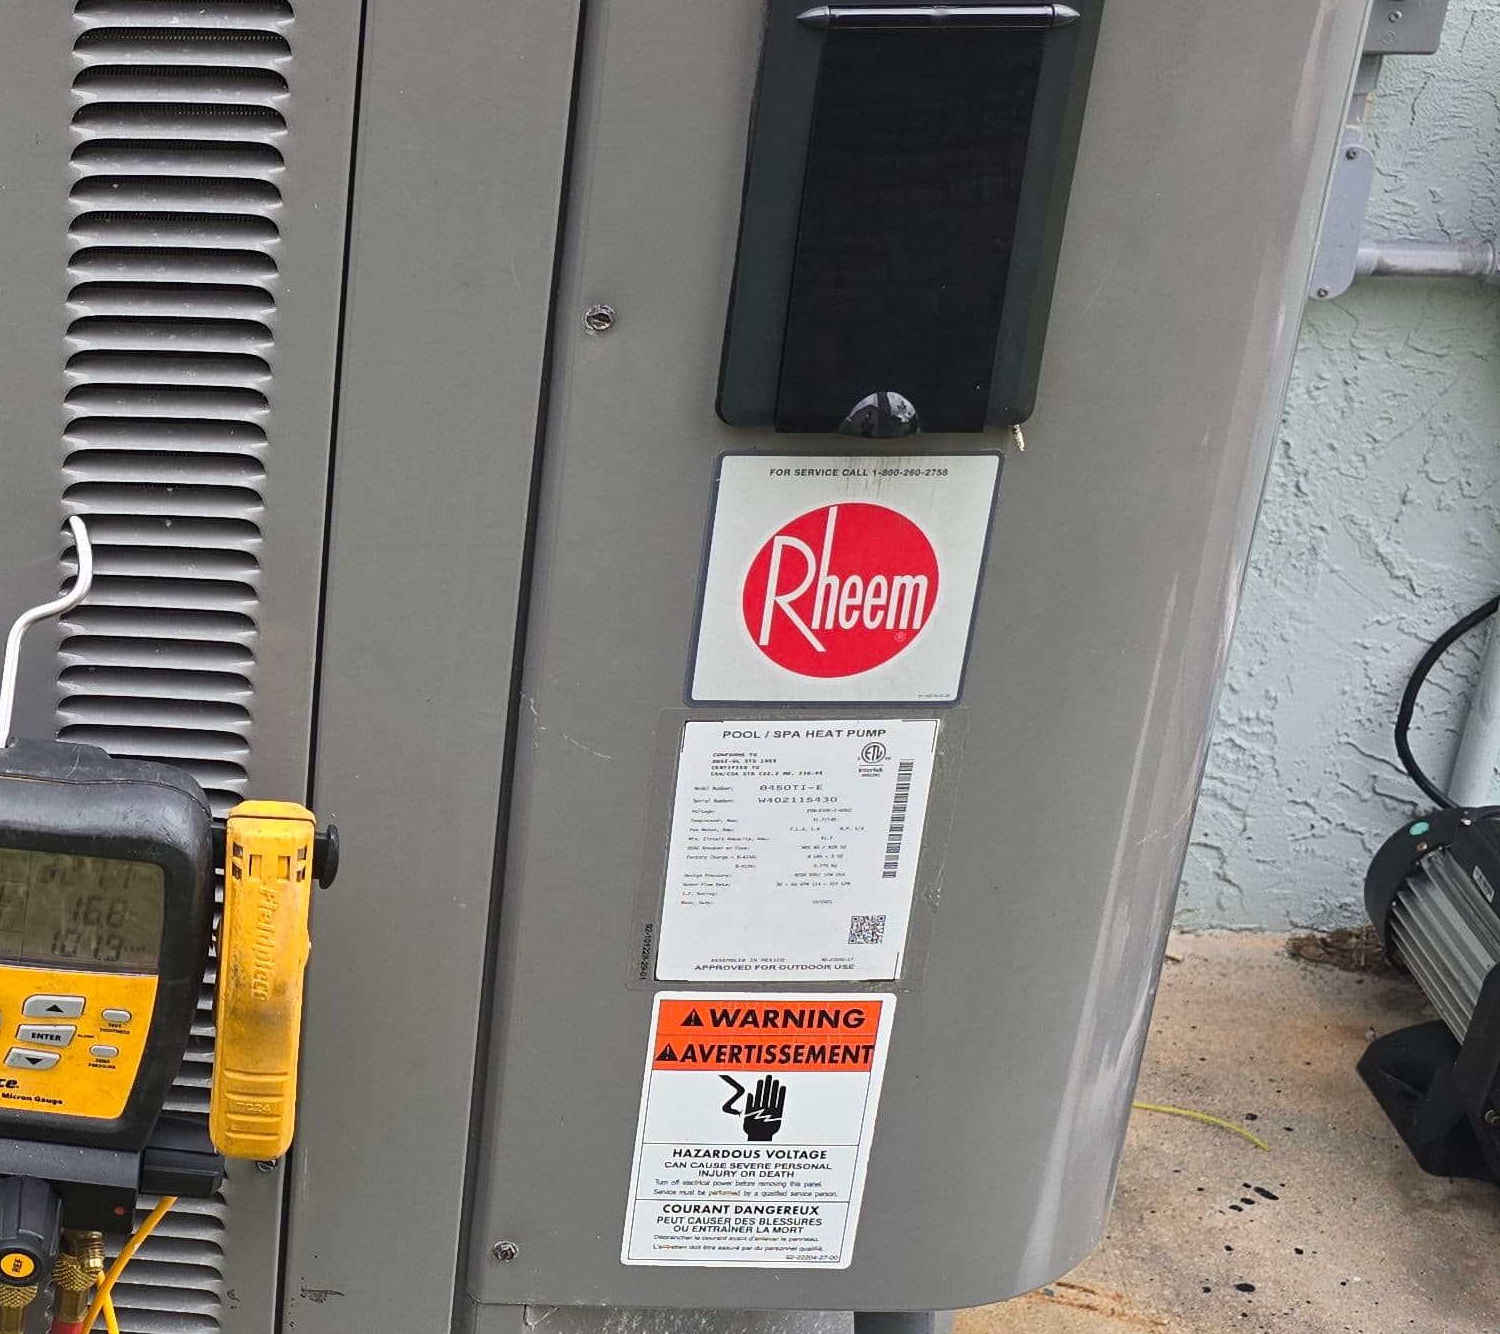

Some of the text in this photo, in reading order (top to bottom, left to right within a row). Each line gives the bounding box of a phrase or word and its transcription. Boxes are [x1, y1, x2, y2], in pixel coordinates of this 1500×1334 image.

[769, 468, 790, 477] FOR
[794, 468, 839, 477] SERVICE
[842, 468, 868, 477] CALL
[759, 505, 928, 652] Rheem
[722, 730, 761, 739] POOL
[773, 730, 800, 739] SPA
[805, 729, 843, 738] HEAT
[846, 729, 887, 737] PUMP
[252, 885, 278, 1004] Fieldpiece
[710, 1008, 866, 1029] WARNING
[31, 1033, 62, 1042] ENTER
[680, 1044, 876, 1064] AVERTISSEMENT
[1, 1092, 33, 1101] Micron
[34, 1095, 64, 1105] Gauge
[672, 1149, 828, 1160] HAZARDOUS VOLTAGE
[698, 1170, 738, 1178] INJURY
[740, 1170, 756, 1178] OR
[735, 1179, 755, 1187] before
[758, 1180, 787, 1189] removing
[708, 1189, 741, 1197] performed
[662, 1203, 820, 1215] COURANT DANGEREUX
[688, 1217, 732, 1225] CAUSER
[734, 1217, 756, 1225] DES
[759, 1218, 823, 1226] BLESSURES
[673, 1225, 689, 1233] OU
[773, 1226, 805, 1234] MORT
